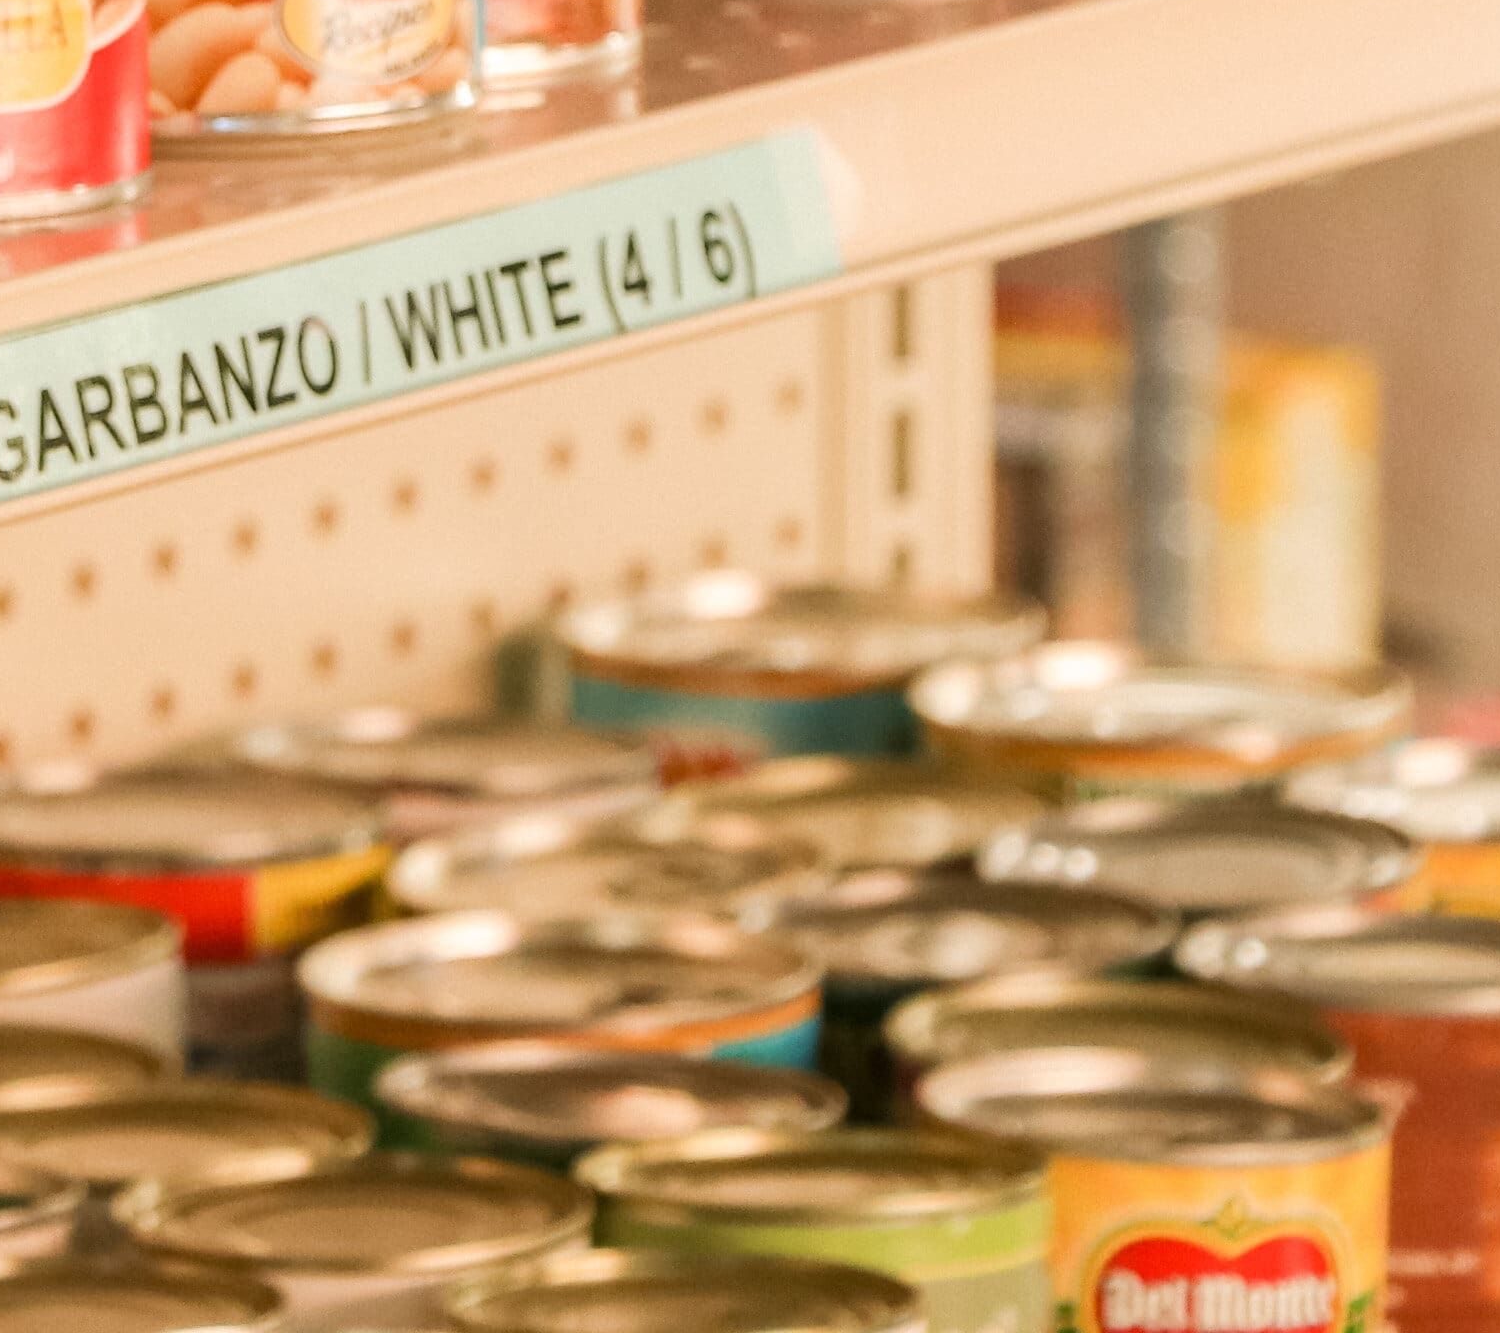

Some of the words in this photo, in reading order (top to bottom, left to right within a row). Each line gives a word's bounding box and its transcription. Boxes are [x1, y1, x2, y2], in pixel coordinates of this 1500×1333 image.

[358, 300, 374, 385] /
[385, 247, 584, 372] WHITE
[598, 229, 652, 337] (4
[665, 215, 681, 298] /
[702, 200, 758, 302] 6)
